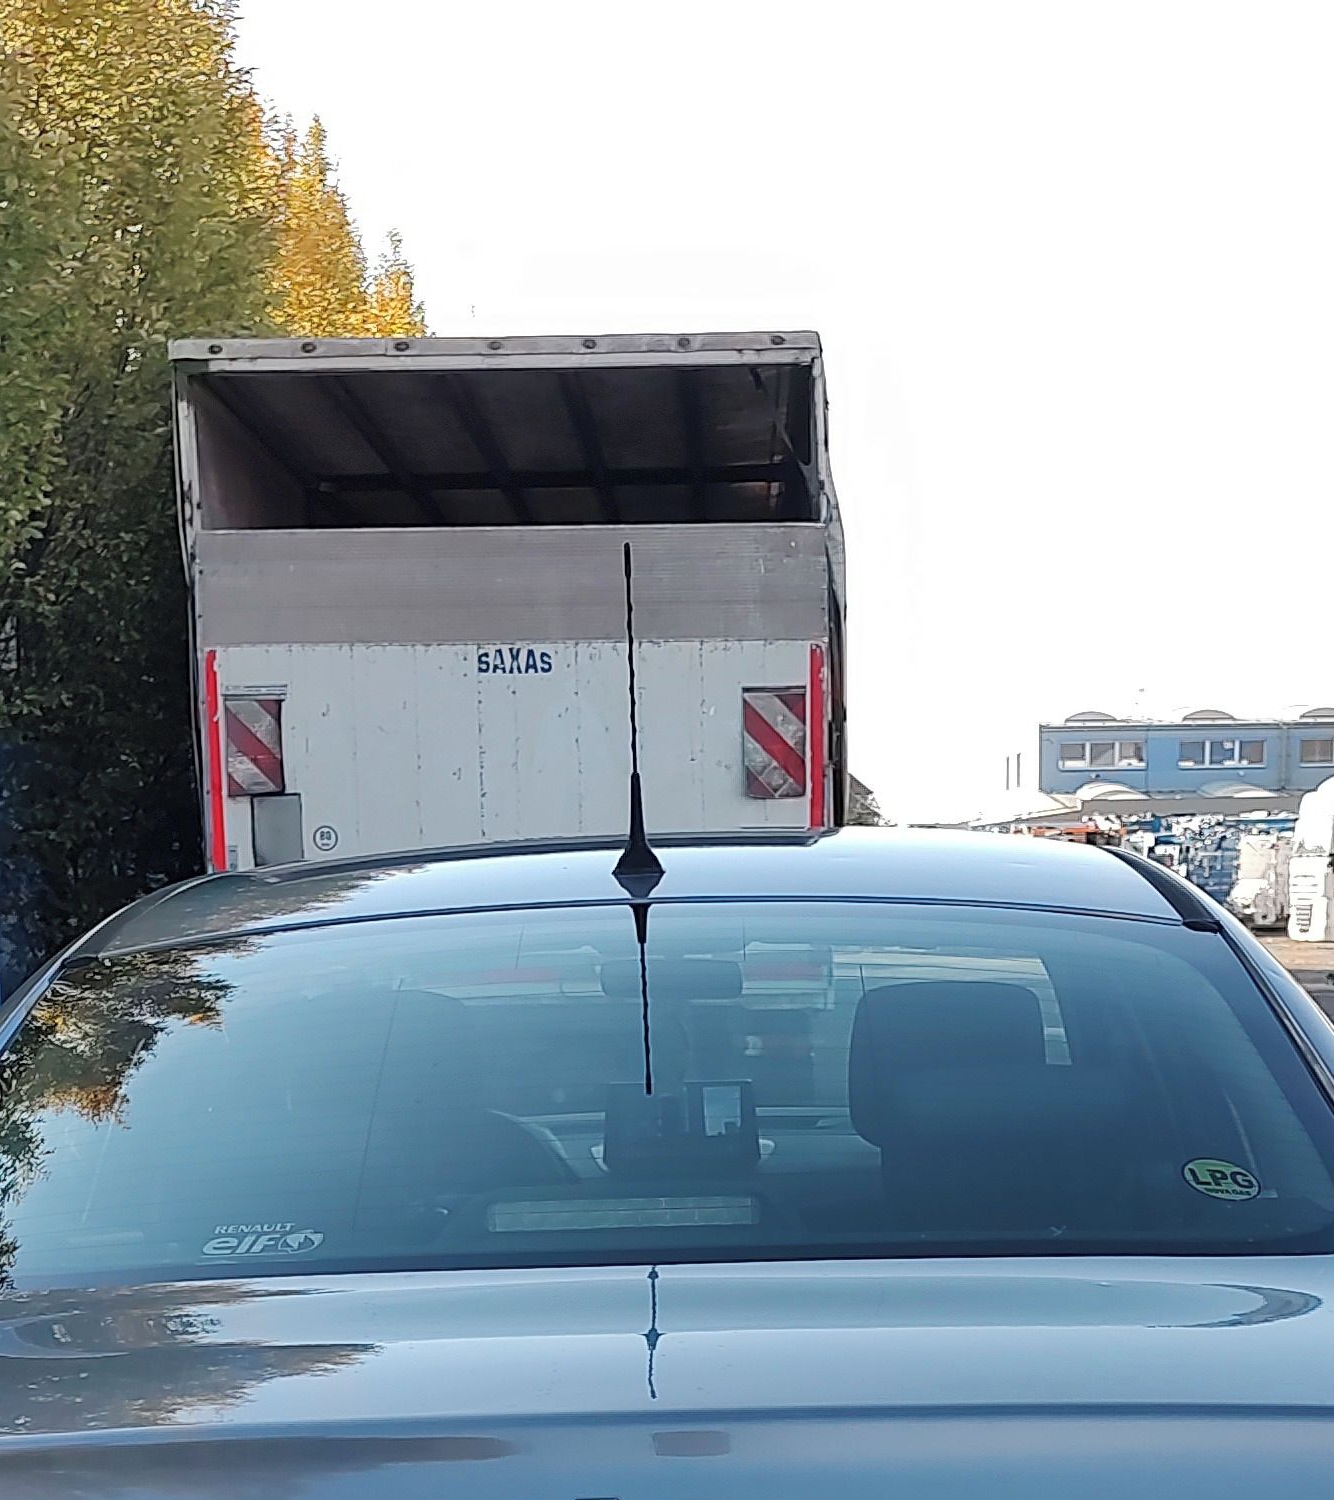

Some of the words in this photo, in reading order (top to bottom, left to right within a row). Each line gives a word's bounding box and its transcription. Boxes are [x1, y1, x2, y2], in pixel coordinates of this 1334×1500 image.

[477, 647, 553, 674] SAXAS
[1187, 1167, 1254, 1189] LPG
[214, 1222, 296, 1235] RENAULT
